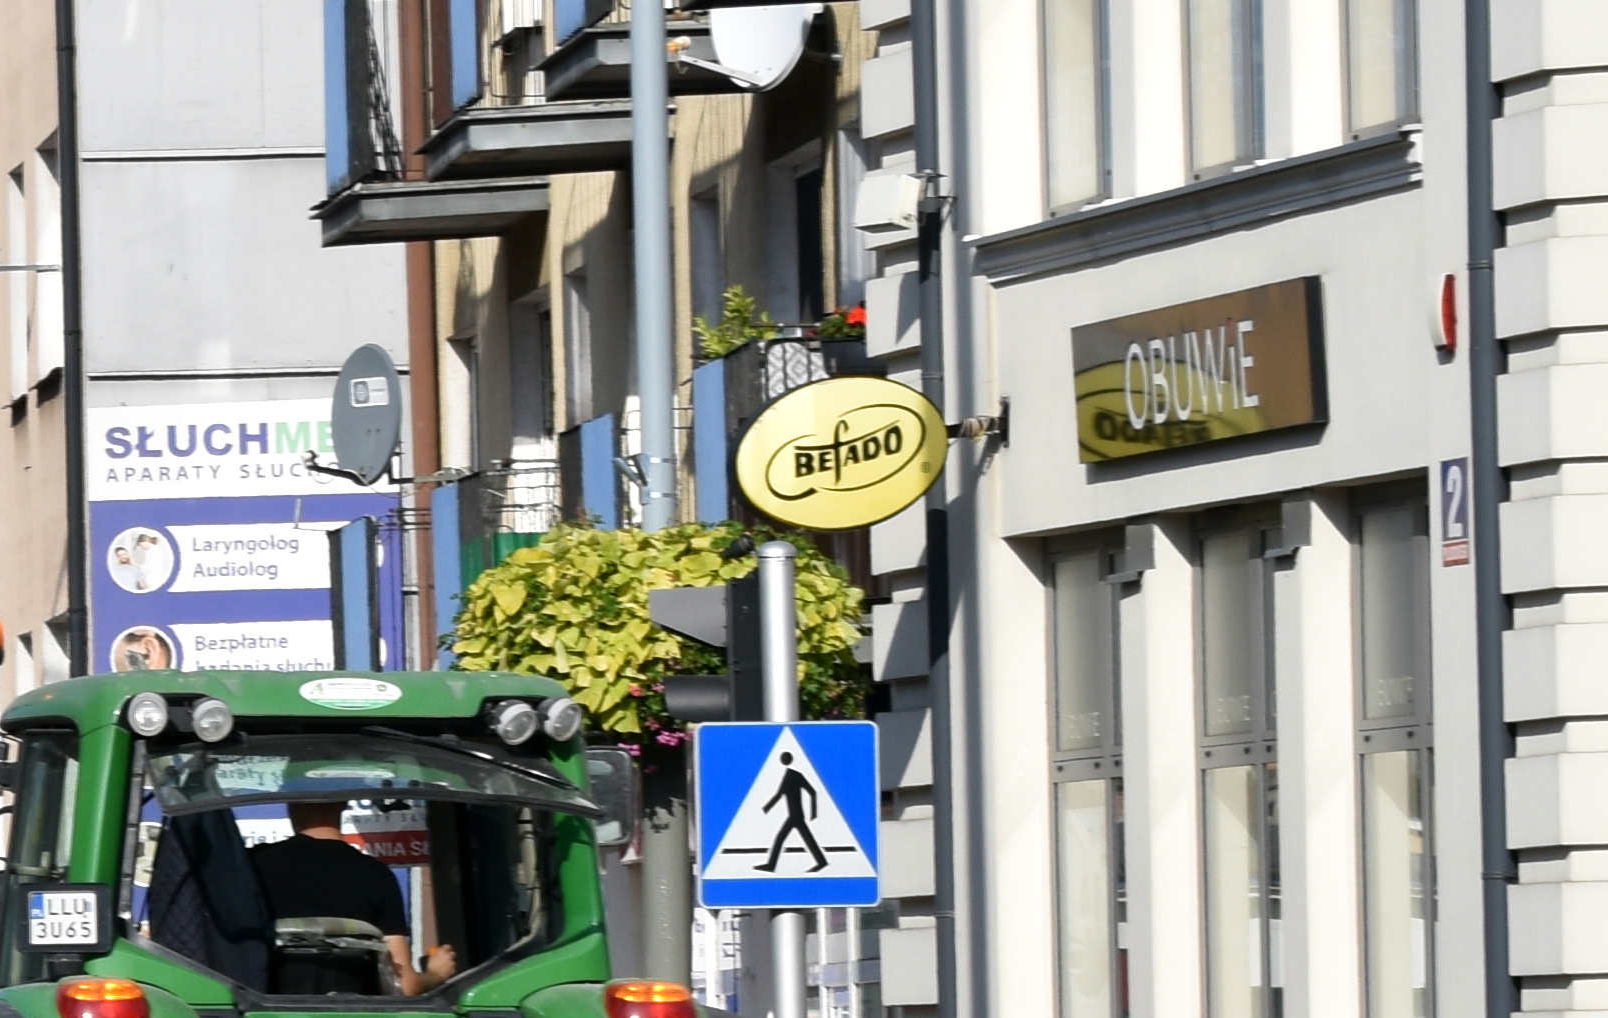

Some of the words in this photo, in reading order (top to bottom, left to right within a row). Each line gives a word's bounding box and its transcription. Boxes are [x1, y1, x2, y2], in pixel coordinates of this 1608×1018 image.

[105, 421, 335, 459] SŁUCHME
[106, 465, 222, 482] APARATY
[1447, 465, 1464, 538] 2
[192, 535, 299, 554] Laryngolog
[192, 562, 278, 580] Audiolog
[194, 634, 289, 652] Bezpłatne
[47, 898, 87, 916] LLU
[36, 921, 91, 939] 3U65
